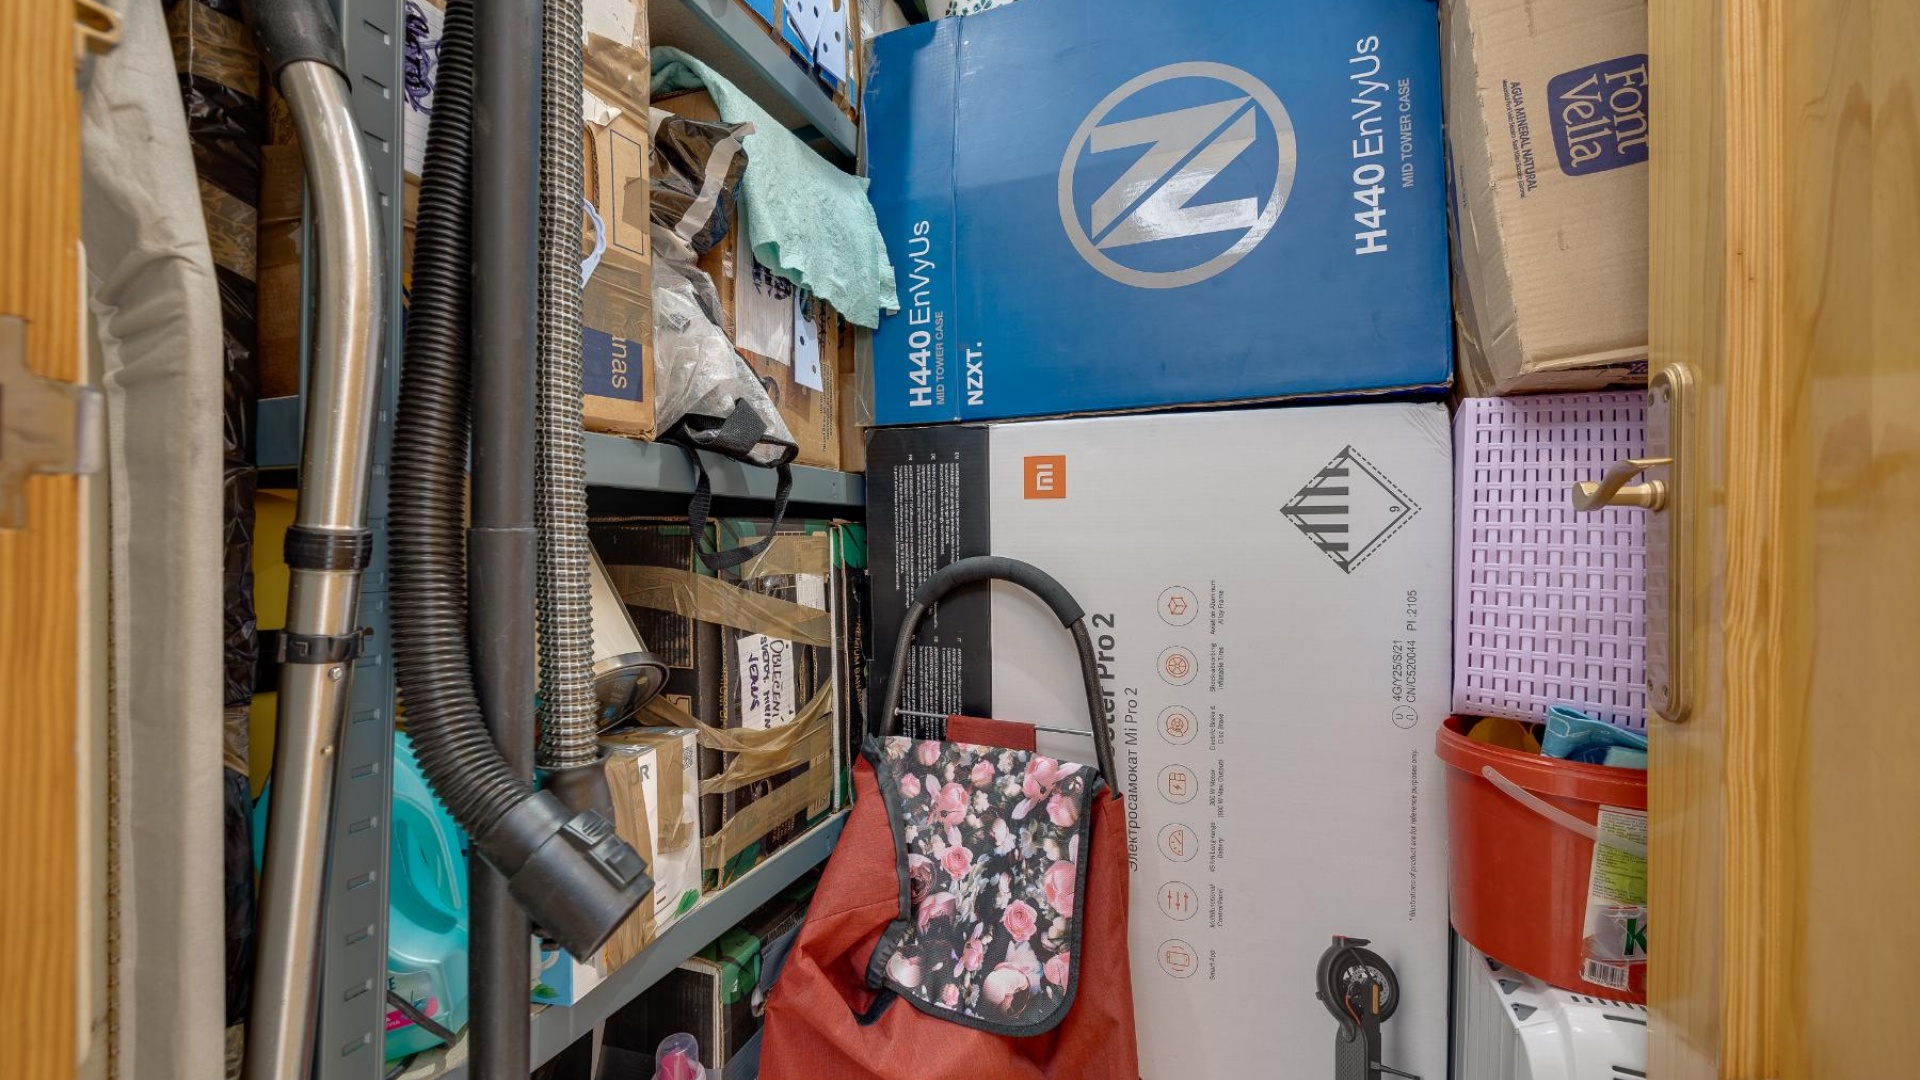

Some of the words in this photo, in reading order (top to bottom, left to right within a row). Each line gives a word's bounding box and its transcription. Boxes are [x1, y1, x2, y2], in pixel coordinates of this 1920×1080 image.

[1349, 36, 1389, 158] EnVyUs
[1397, 78, 1410, 111] CASE
[1510, 81, 1523, 107] AGUA
[1604, 64, 1648, 154] Font
[1399, 115, 1413, 161] TOWER
[1515, 107, 1531, 149] MINERAL
[1559, 74, 1613, 167] Vella
[1402, 163, 1414, 188] MID
[1522, 149, 1537, 192] NATURAL
[1353, 163, 1387, 255] H440
[909, 220, 936, 325] EnVyUs
[935, 311, 944, 340] CASE
[909, 330, 932, 407] H440
[935, 342, 944, 381] TOWER
[966, 342, 983, 405] NZXT.
[936, 384, 945, 405] MID
[1092, 614, 1114, 628] 2
[1406, 619, 1417, 631] PI
[1097, 635, 1115, 679] Pro
[1406, 640, 1417, 703] CN/C520044
[1124, 687, 1137, 695] 2
[1125, 700, 1137, 724] Pro
[1124, 727, 1137, 746] Mi
